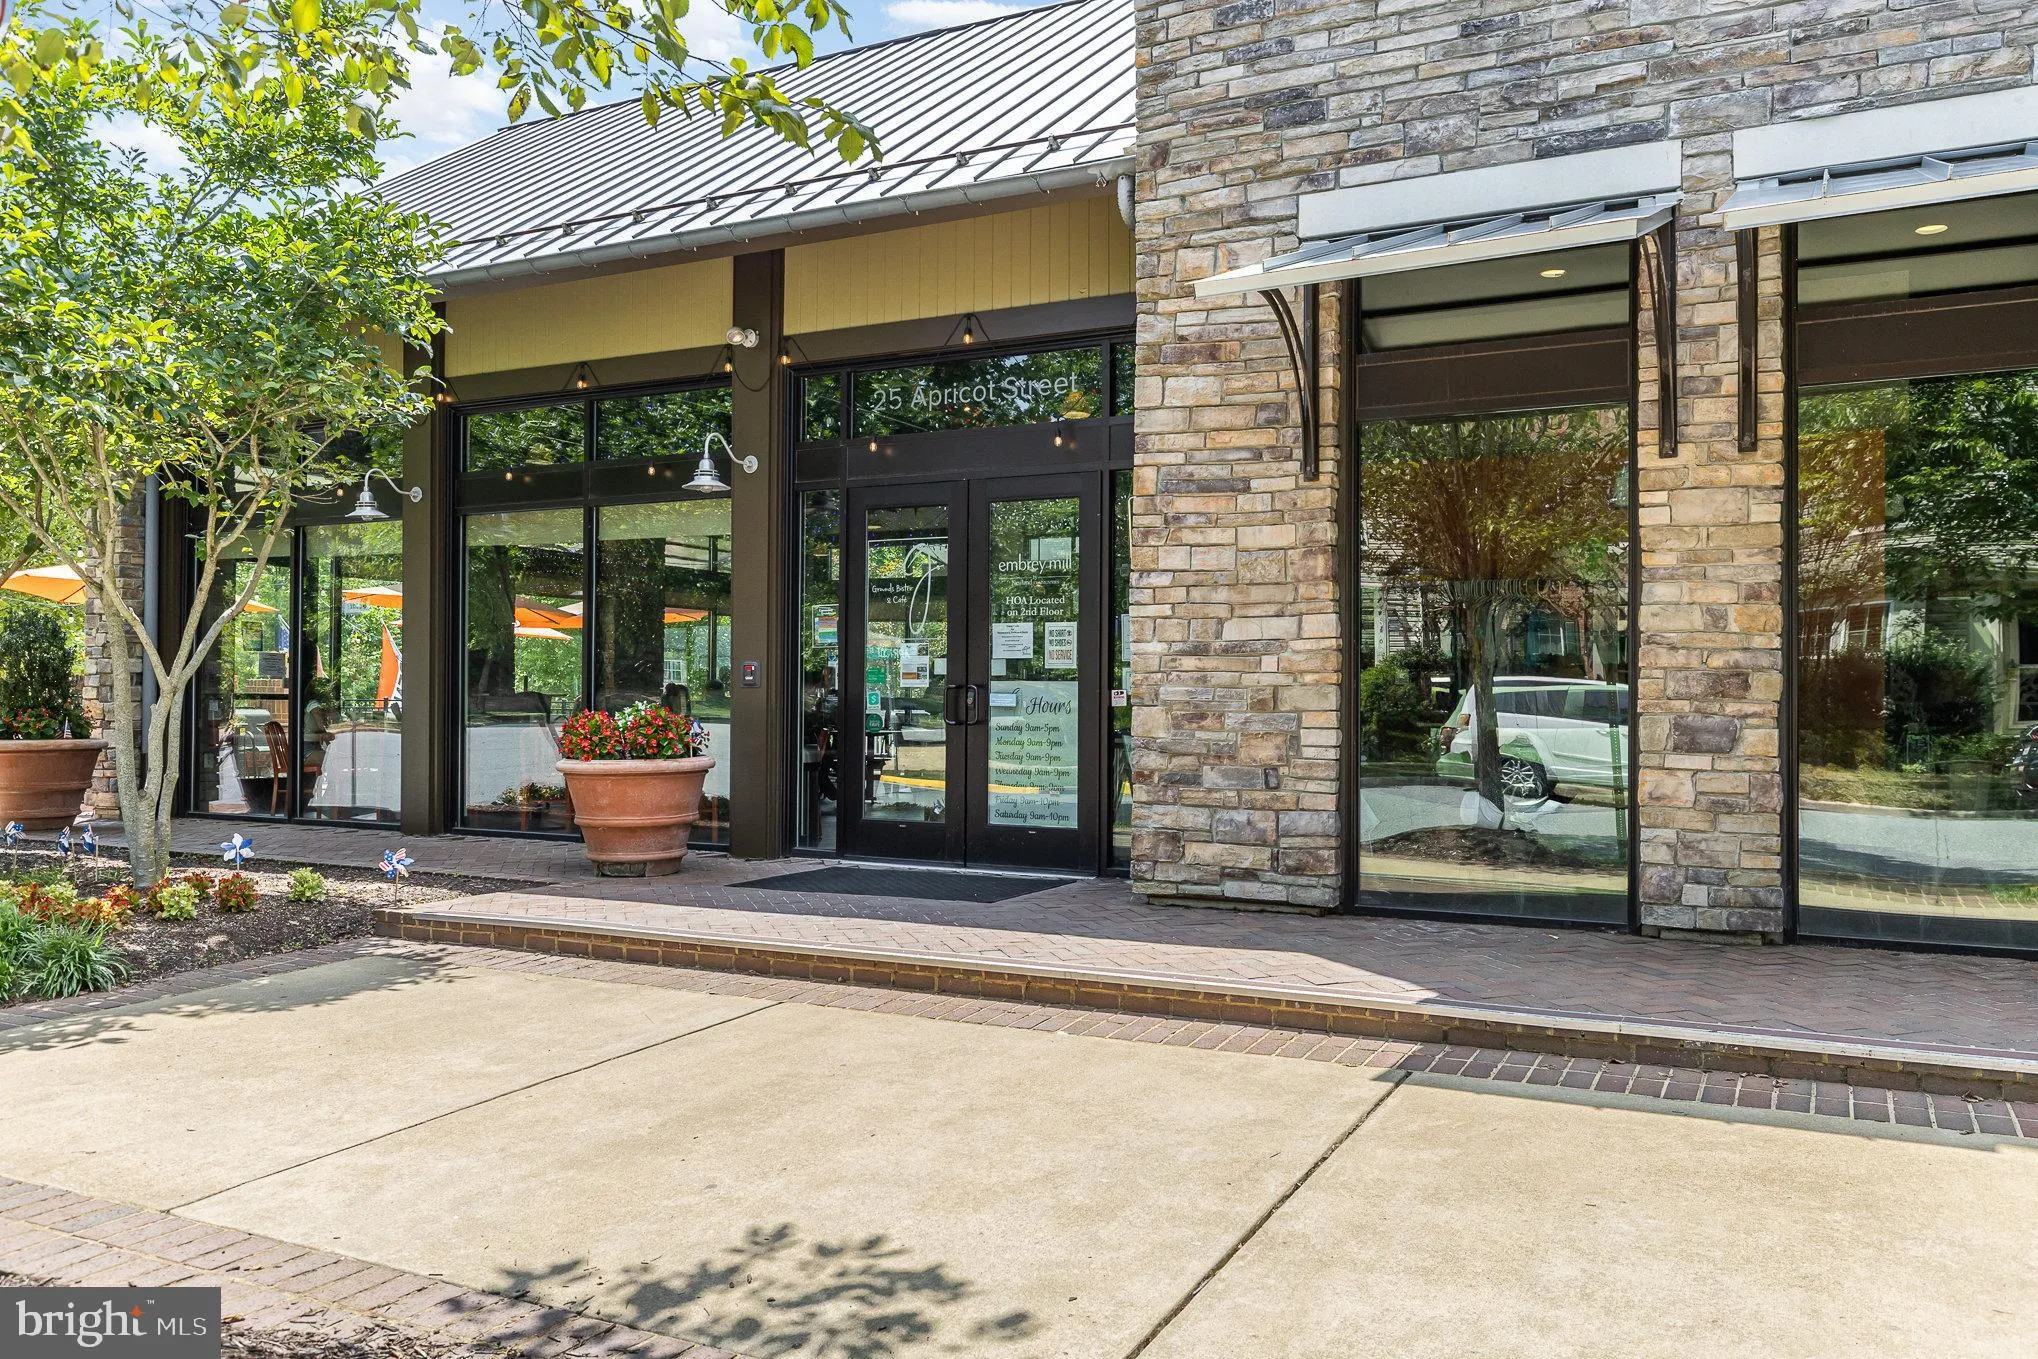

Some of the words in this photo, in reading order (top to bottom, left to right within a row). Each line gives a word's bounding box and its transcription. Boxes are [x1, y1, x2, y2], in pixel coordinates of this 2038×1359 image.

[873, 388, 902, 411] 25
[911, 380, 1000, 411] Apricot
[1002, 372, 1079, 399] Street
[998, 553, 1046, 574] embrey
[1049, 555, 1072, 570] mill
[1006, 596, 1027, 605] HOA
[1030, 595, 1065, 604] Located
[1020, 607, 1037, 616] 2nd
[1040, 607, 1064, 616] Floor
[1026, 695, 1072, 715] Hours
[995, 722, 1023, 735] Sunday
[1025, 722, 1060, 736] 9am-5pm
[995, 736, 1025, 750] Monday
[1026, 737, 1063, 750] 9am-9pm
[995, 751, 1023, 765] Tuesday
[1025, 752, 1062, 765] 9am-9pm
[995, 767, 1032, 779] Wednesday
[1034, 768, 1071, 780] 9am-9pm
[994, 795, 1018, 808] Friday
[994, 809, 1028, 823] Saturday
[1029, 810, 1070, 824] 9am-10pm
